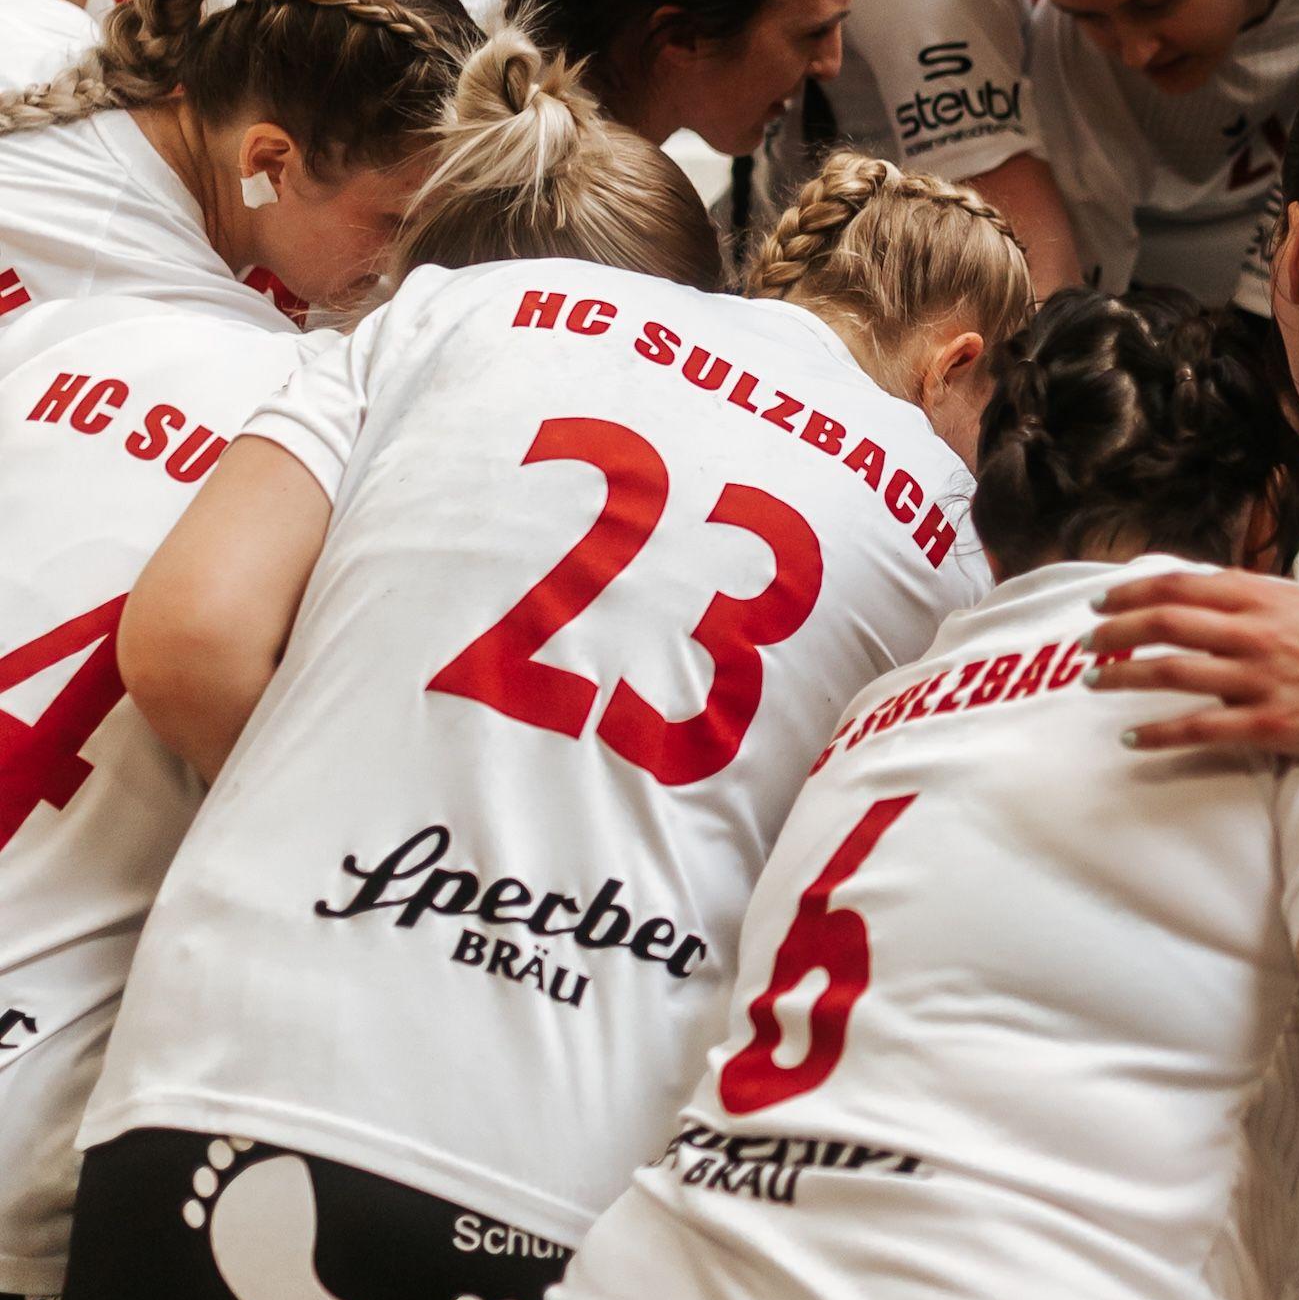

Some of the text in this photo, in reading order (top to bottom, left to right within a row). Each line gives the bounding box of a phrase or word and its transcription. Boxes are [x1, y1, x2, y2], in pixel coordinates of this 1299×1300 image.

[895, 80, 1021, 140] steubl
[25, 373, 129, 435] HC
[511, 291, 957, 569] HC SULZBACH
[425, 417, 824, 786] 23
[844, 639, 1134, 751] SULZBAC
[314, 824, 708, 979] Sperber
[718, 791, 920, 1115] 6
[450, 928, 591, 1009] BRÄU
[451, 1213, 566, 1260] Schu
